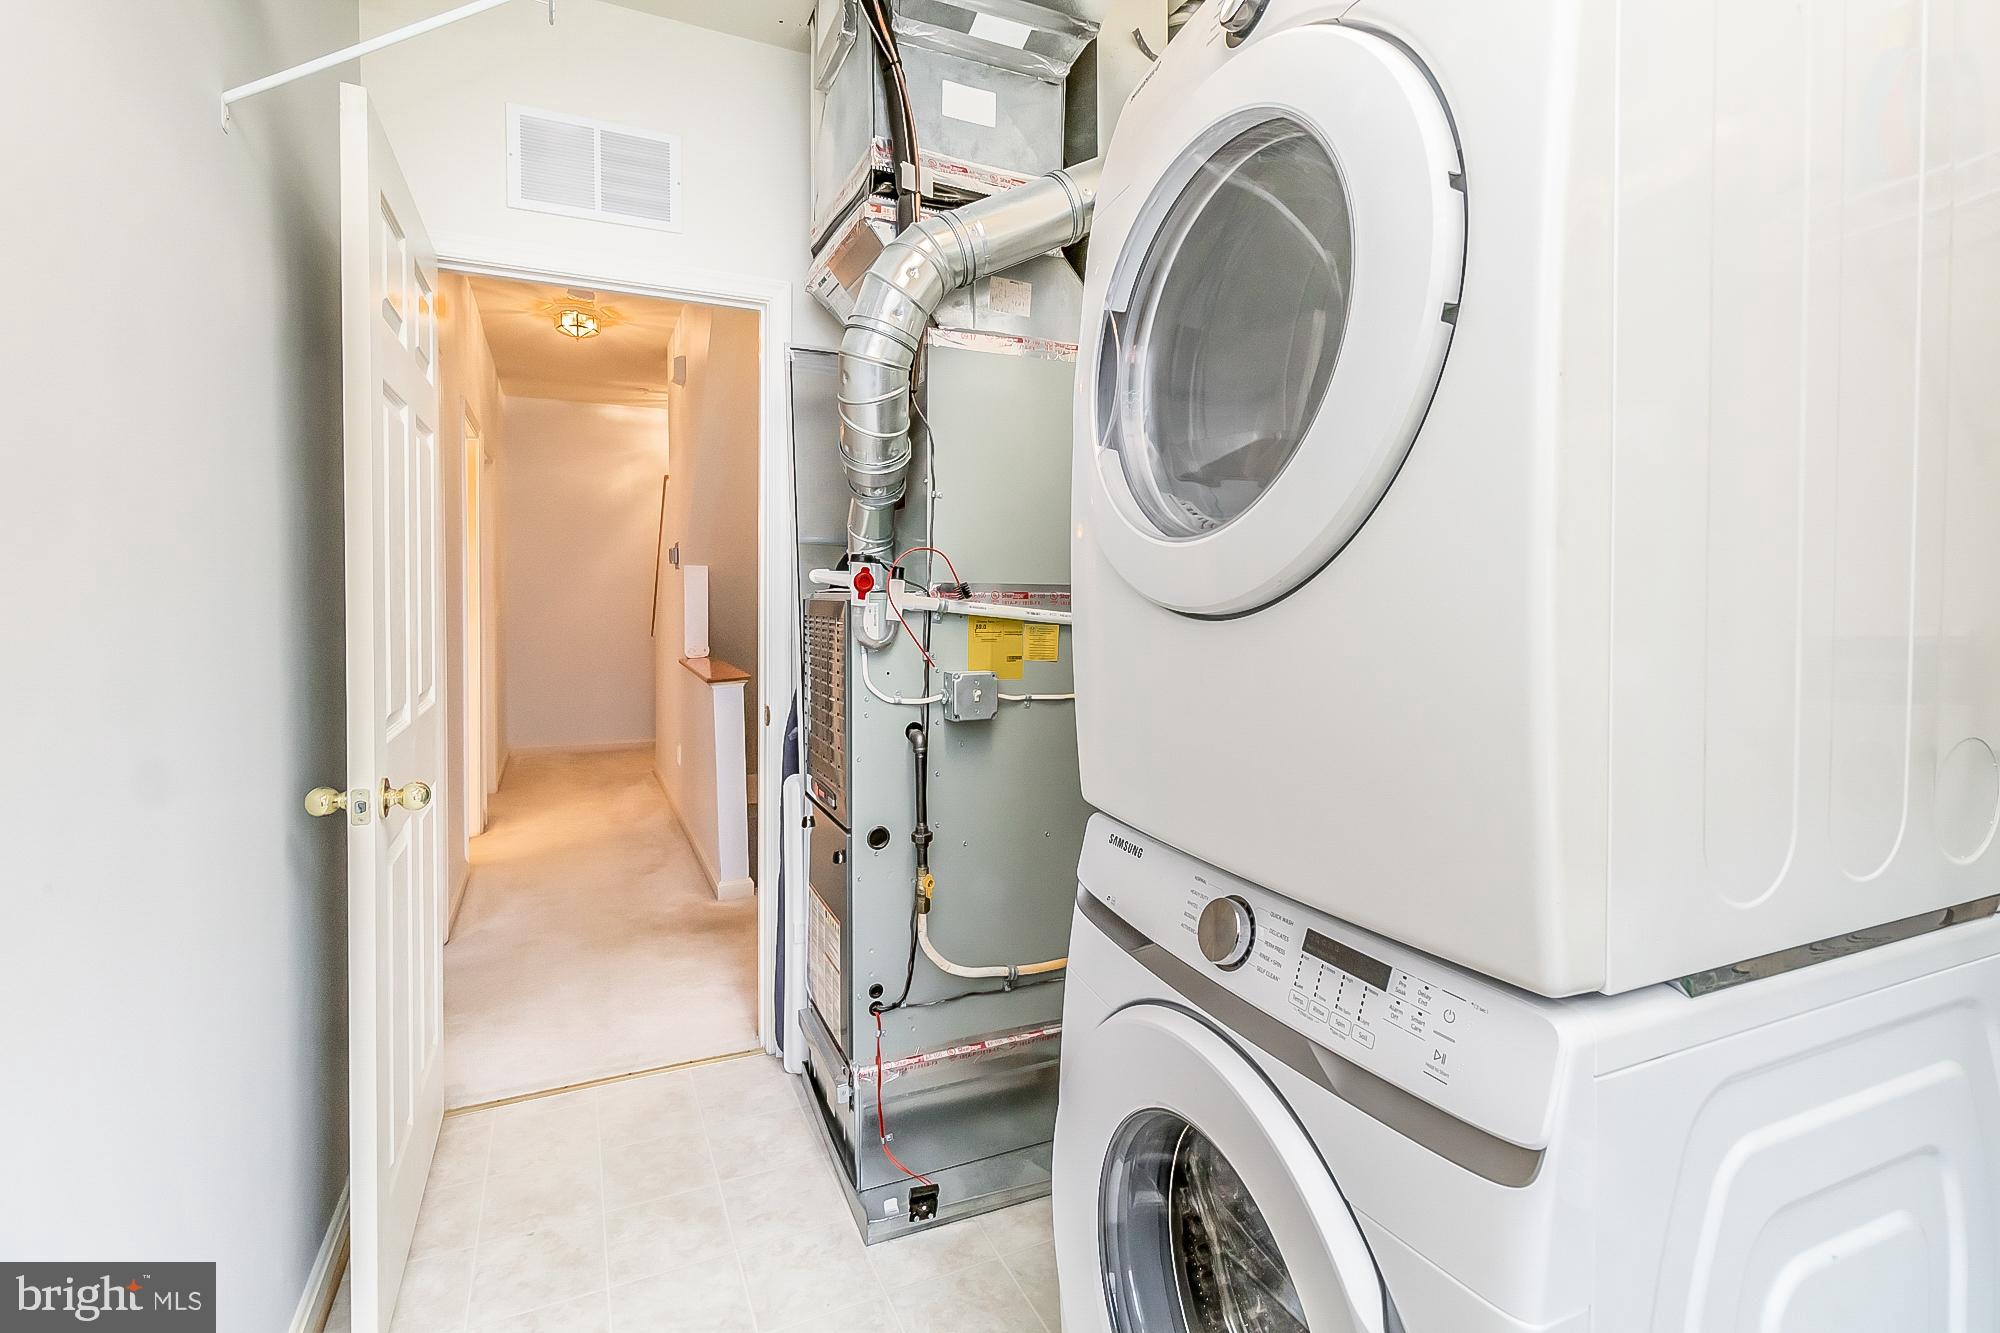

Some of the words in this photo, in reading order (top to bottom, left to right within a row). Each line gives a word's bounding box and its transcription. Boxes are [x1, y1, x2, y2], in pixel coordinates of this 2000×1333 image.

[1108, 833, 1144, 859] SAMSUNG
[1269, 911, 1282, 921] QUICK
[1282, 916, 1294, 926] WASH
[1269, 928, 1289, 942] DELICATES
[1274, 945, 1286, 956] PRESS
[1417, 989, 1432, 1001] Delay
[1418, 998, 1428, 1007] End
[1389, 1004, 1404, 1015] Alarm
[1390, 1012, 1399, 1021] Off
[1411, 1015, 1426, 1026] Smart
[1411, 1023, 1422, 1033] Care
[1358, 1031, 1368, 1042] Soil
